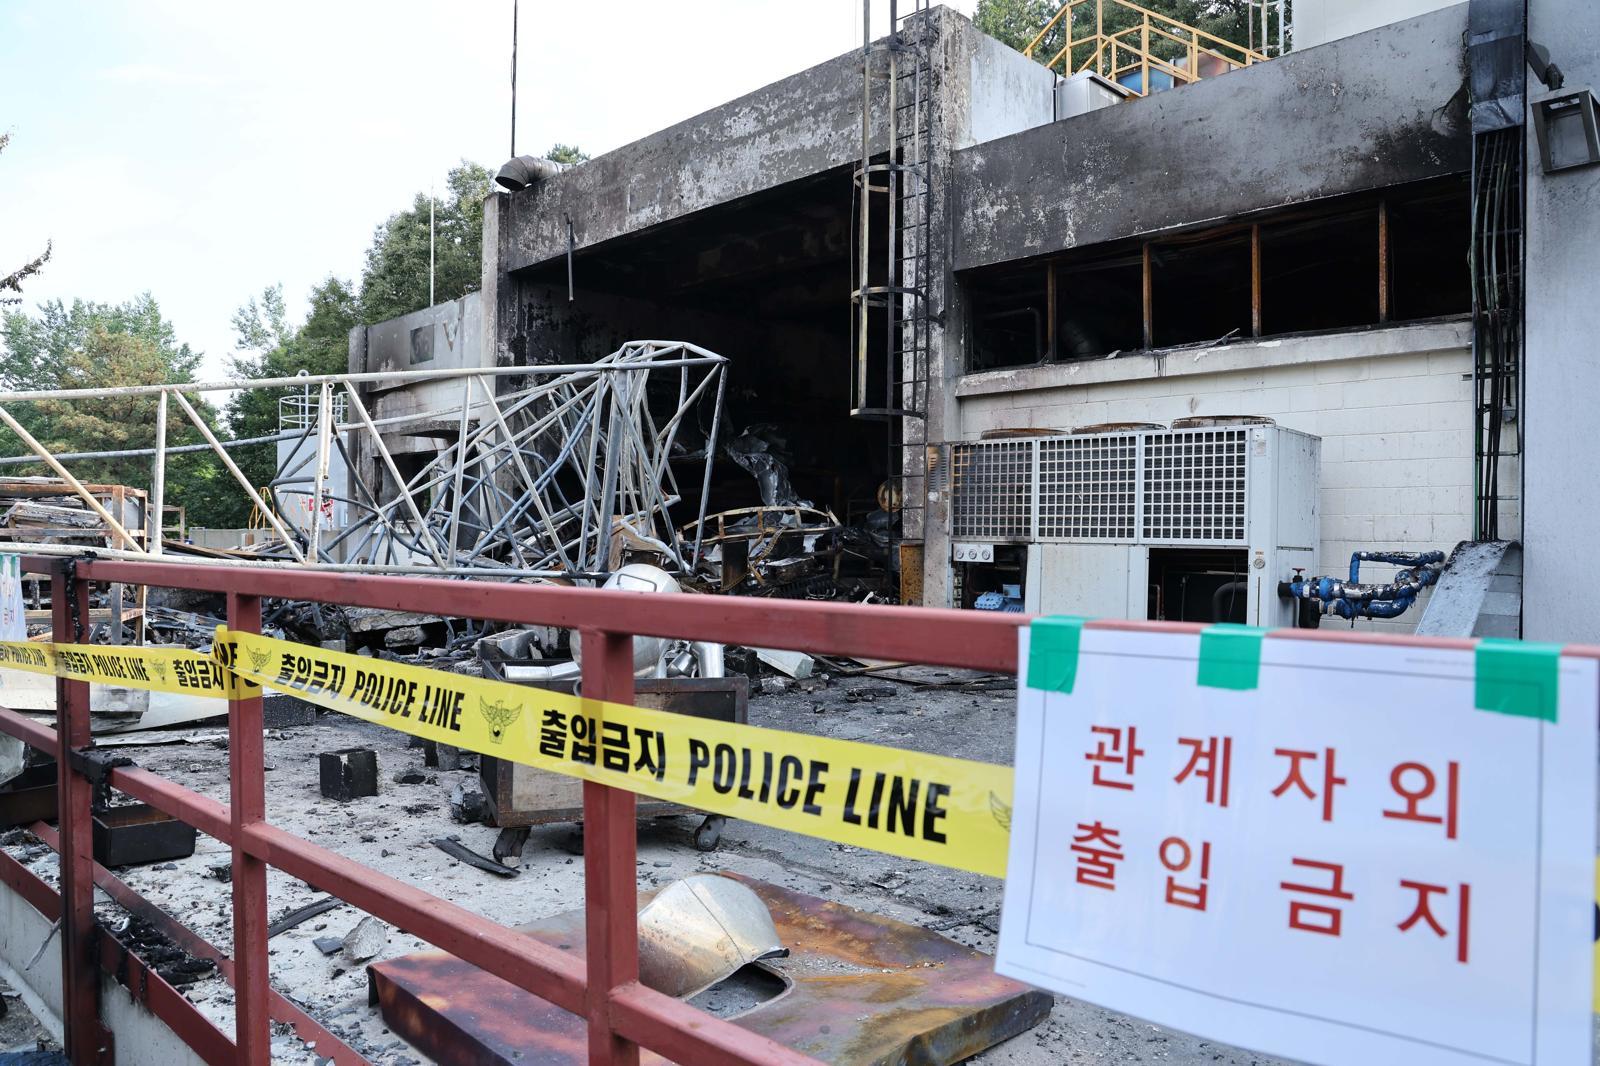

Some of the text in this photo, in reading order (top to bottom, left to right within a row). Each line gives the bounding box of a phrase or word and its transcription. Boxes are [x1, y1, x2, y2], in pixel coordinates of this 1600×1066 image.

[92, 654, 127, 679] POLICE
[124, 656, 151, 681] LINE
[173, 659, 225, 690] 출입금지
[276, 653, 346, 699] 출입금지
[351, 670, 418, 718] POLICE
[419, 690, 466, 732] LINE
[539, 709, 666, 783] 출입금지
[687, 738, 829, 817] POLICE
[842, 767, 951, 845] LINE
